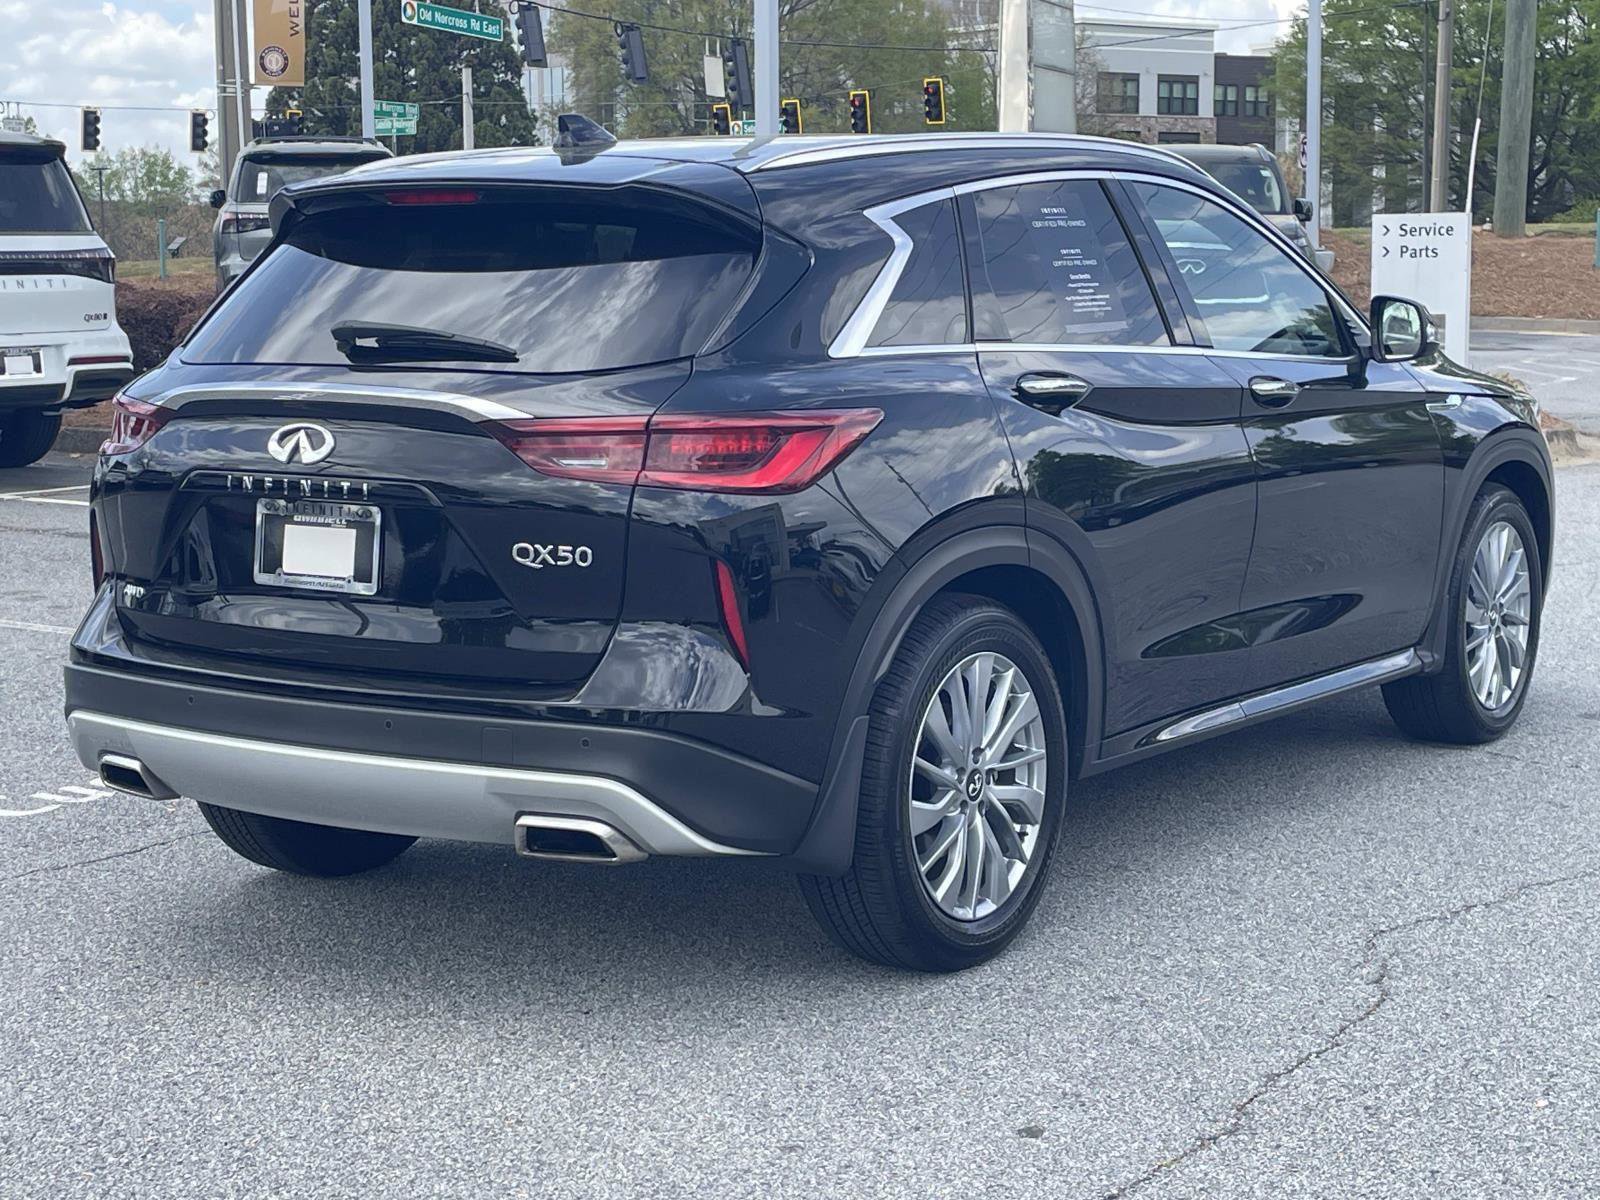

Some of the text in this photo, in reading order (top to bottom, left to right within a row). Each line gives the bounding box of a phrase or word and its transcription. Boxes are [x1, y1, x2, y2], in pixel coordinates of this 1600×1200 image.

[419, 8, 500, 35] Old Norcross Rd East
[1398, 222, 1454, 237] Service
[1399, 245, 1439, 259] Parts
[226, 474, 369, 500] INFINITI
[511, 542, 593, 569] QX50
